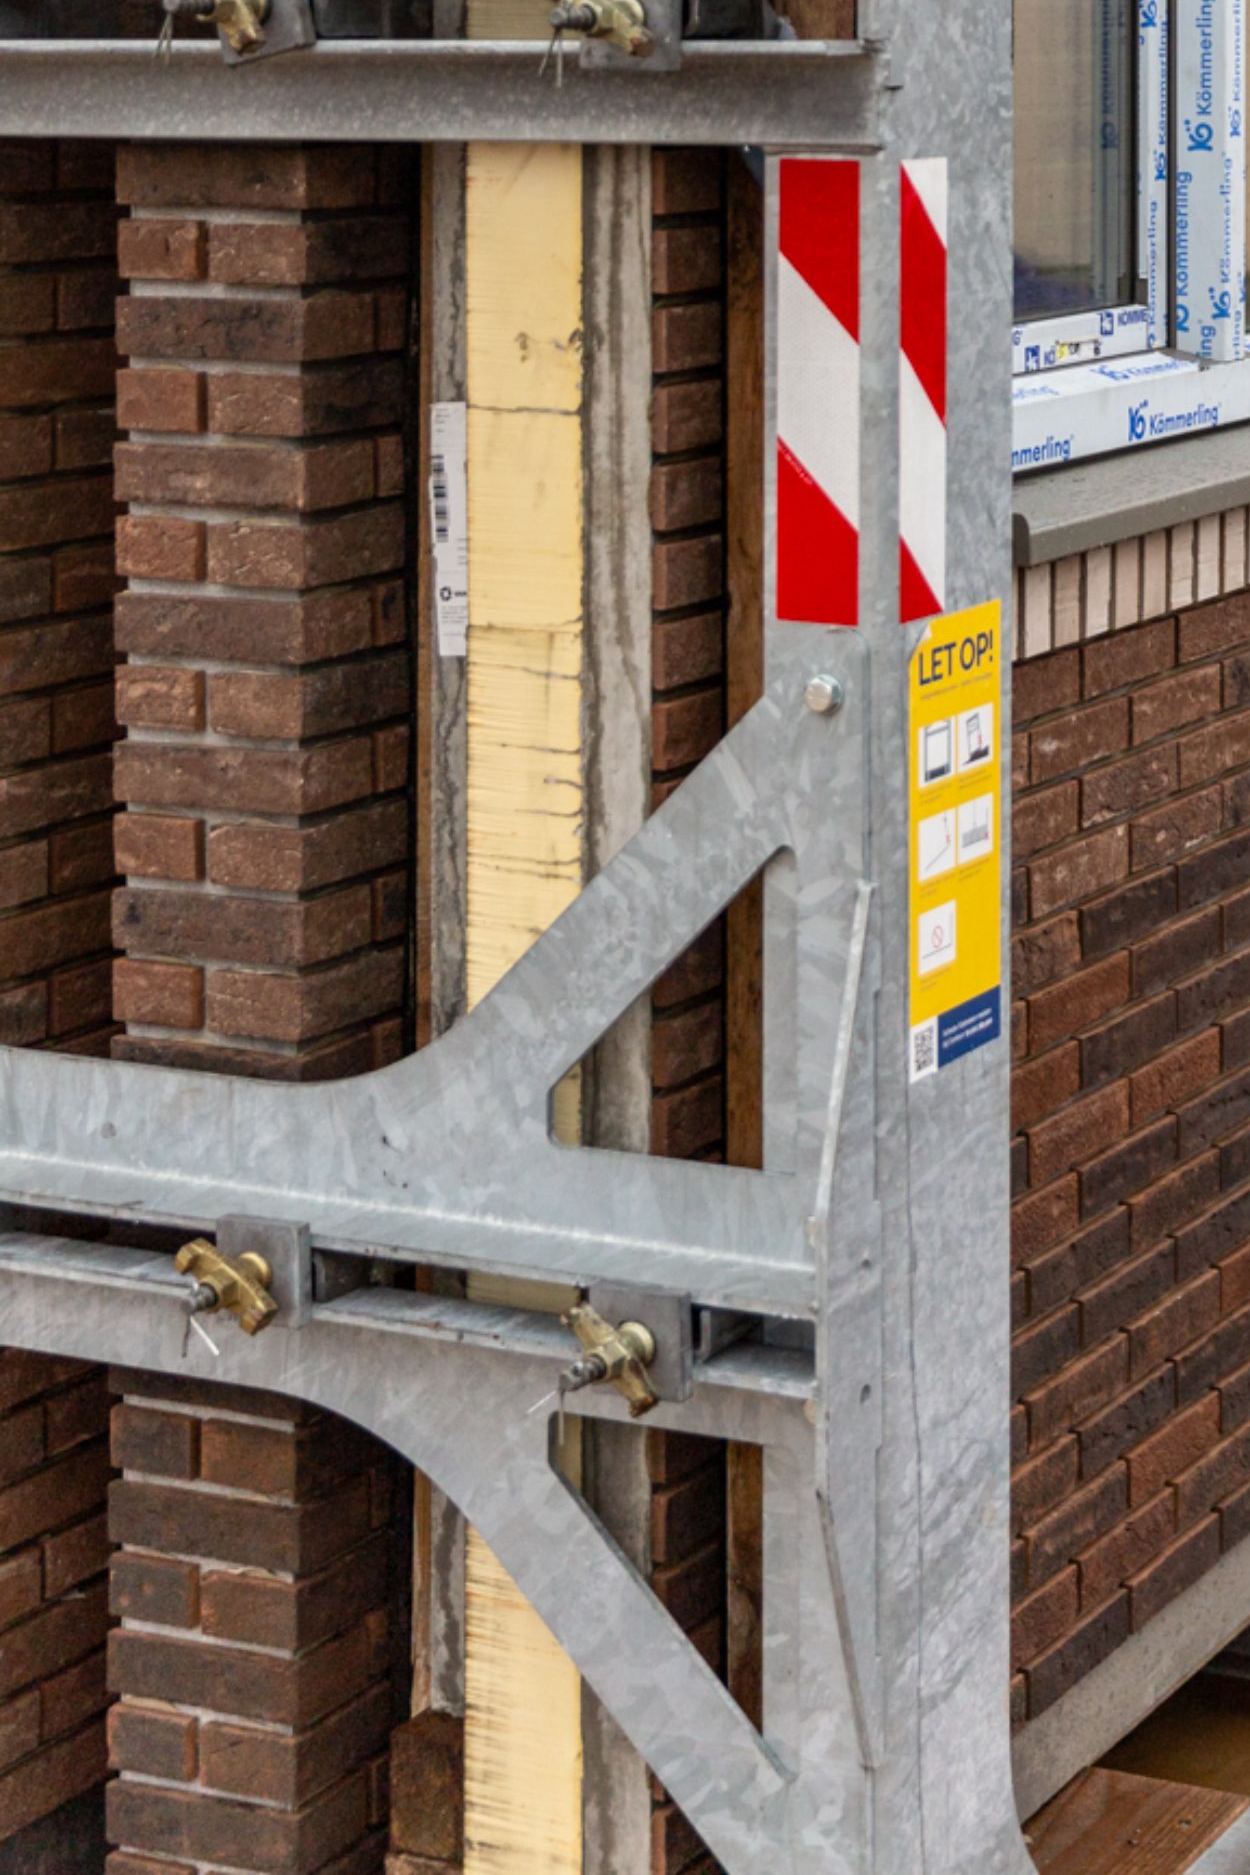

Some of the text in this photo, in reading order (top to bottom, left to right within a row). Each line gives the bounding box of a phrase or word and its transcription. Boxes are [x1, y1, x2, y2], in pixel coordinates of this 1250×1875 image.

[1149, 404, 1219, 435] Kömmerling
[919, 629, 993, 686] LET OP!
